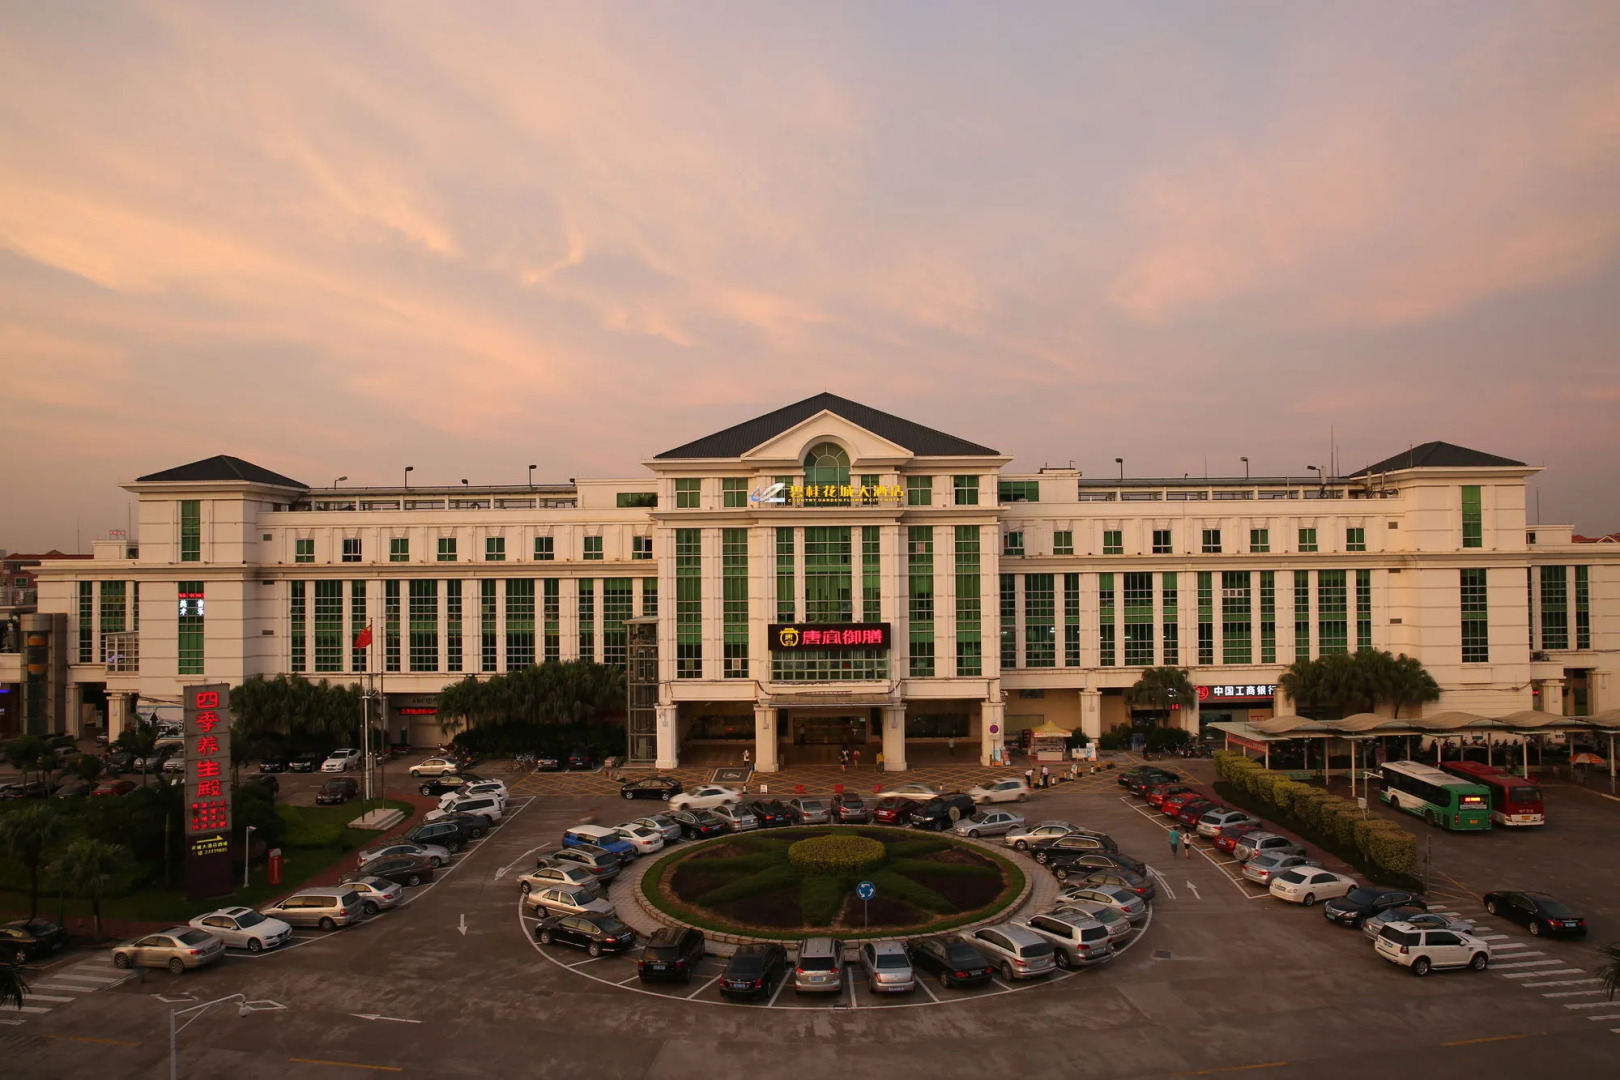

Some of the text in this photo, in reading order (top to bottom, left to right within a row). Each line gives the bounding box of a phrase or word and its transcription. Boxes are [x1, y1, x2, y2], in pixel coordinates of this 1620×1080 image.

[790, 485, 904, 497] 碧桂花城大酒店
[802, 629, 882, 645] 唐宫御膳
[1213, 685, 1276, 696] 中国工商银行
[195, 691, 222, 797] 四季养生殿
